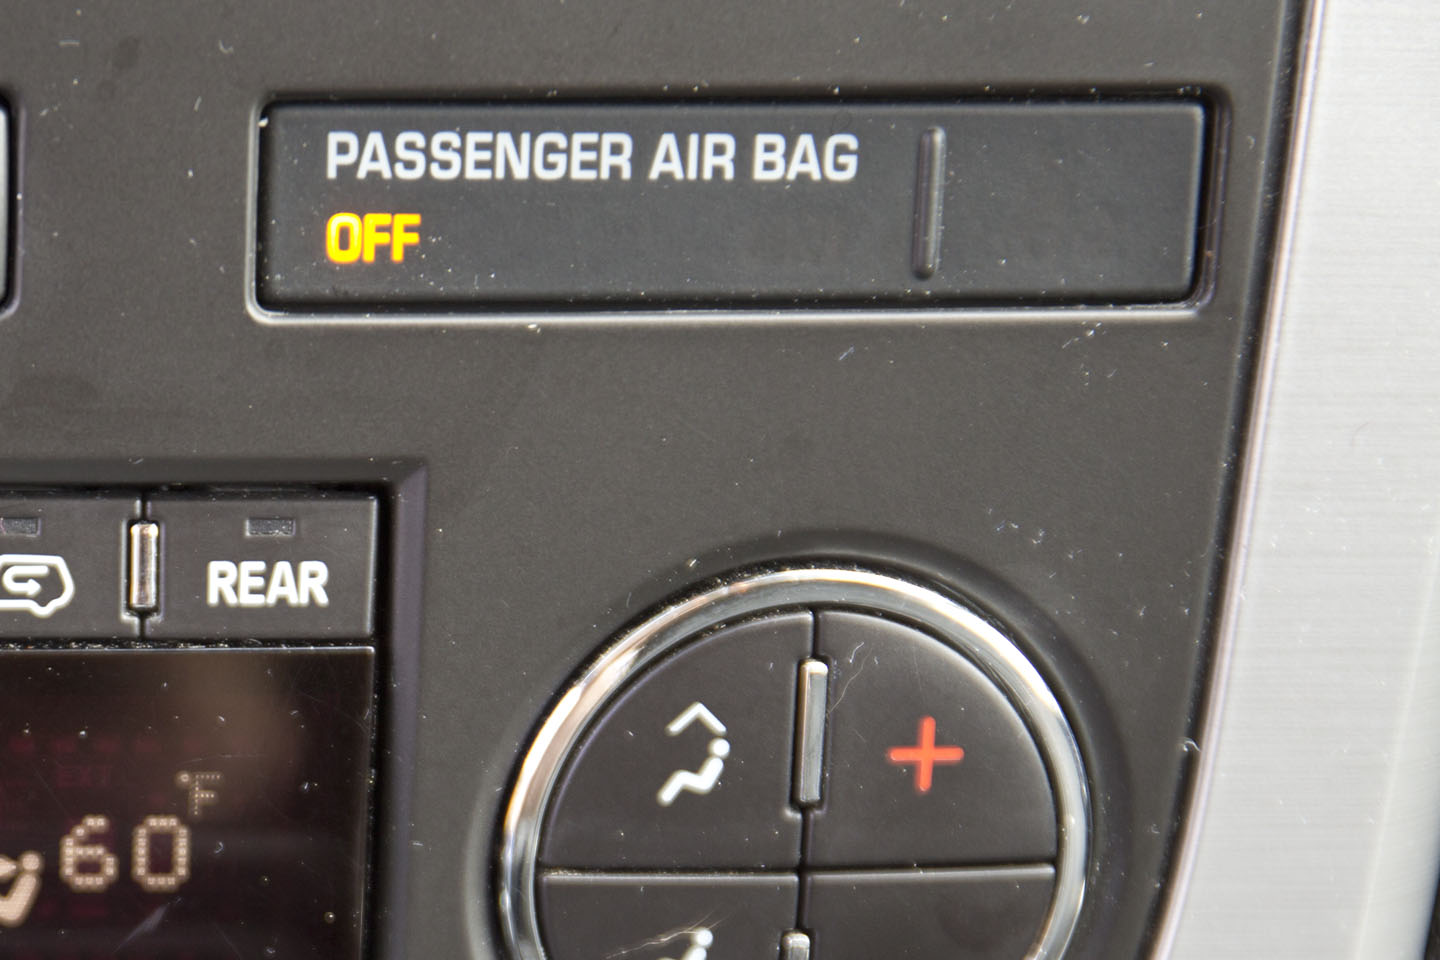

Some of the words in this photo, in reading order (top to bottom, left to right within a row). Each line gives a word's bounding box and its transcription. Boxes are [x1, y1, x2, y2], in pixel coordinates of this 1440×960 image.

[325, 130, 632, 183] PASSENGER
[649, 130, 736, 183] AIR
[752, 130, 860, 183] BAG
[324, 211, 422, 264] OFF
[206, 559, 330, 607] REAR
